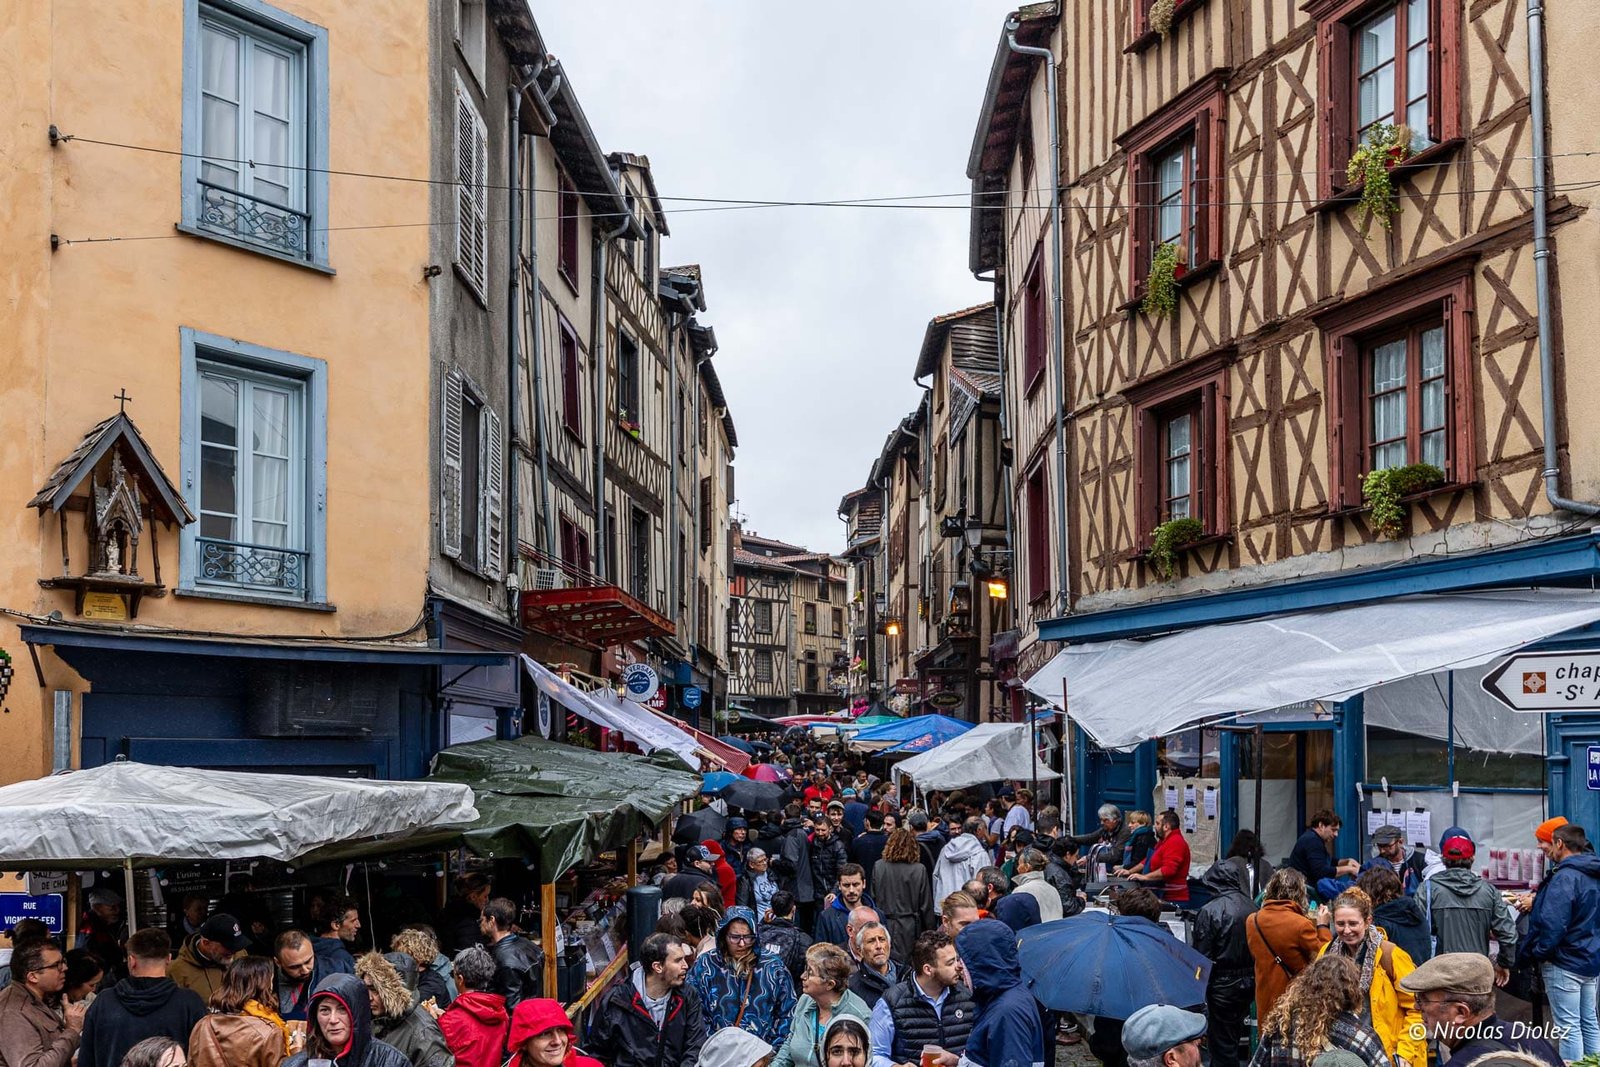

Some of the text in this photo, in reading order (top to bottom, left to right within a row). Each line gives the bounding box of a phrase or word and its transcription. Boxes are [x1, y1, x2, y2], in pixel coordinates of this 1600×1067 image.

[629, 664, 656, 679] VERSANT
[41, 881, 50, 890] DE
[23, 902, 37, 910] RUE
